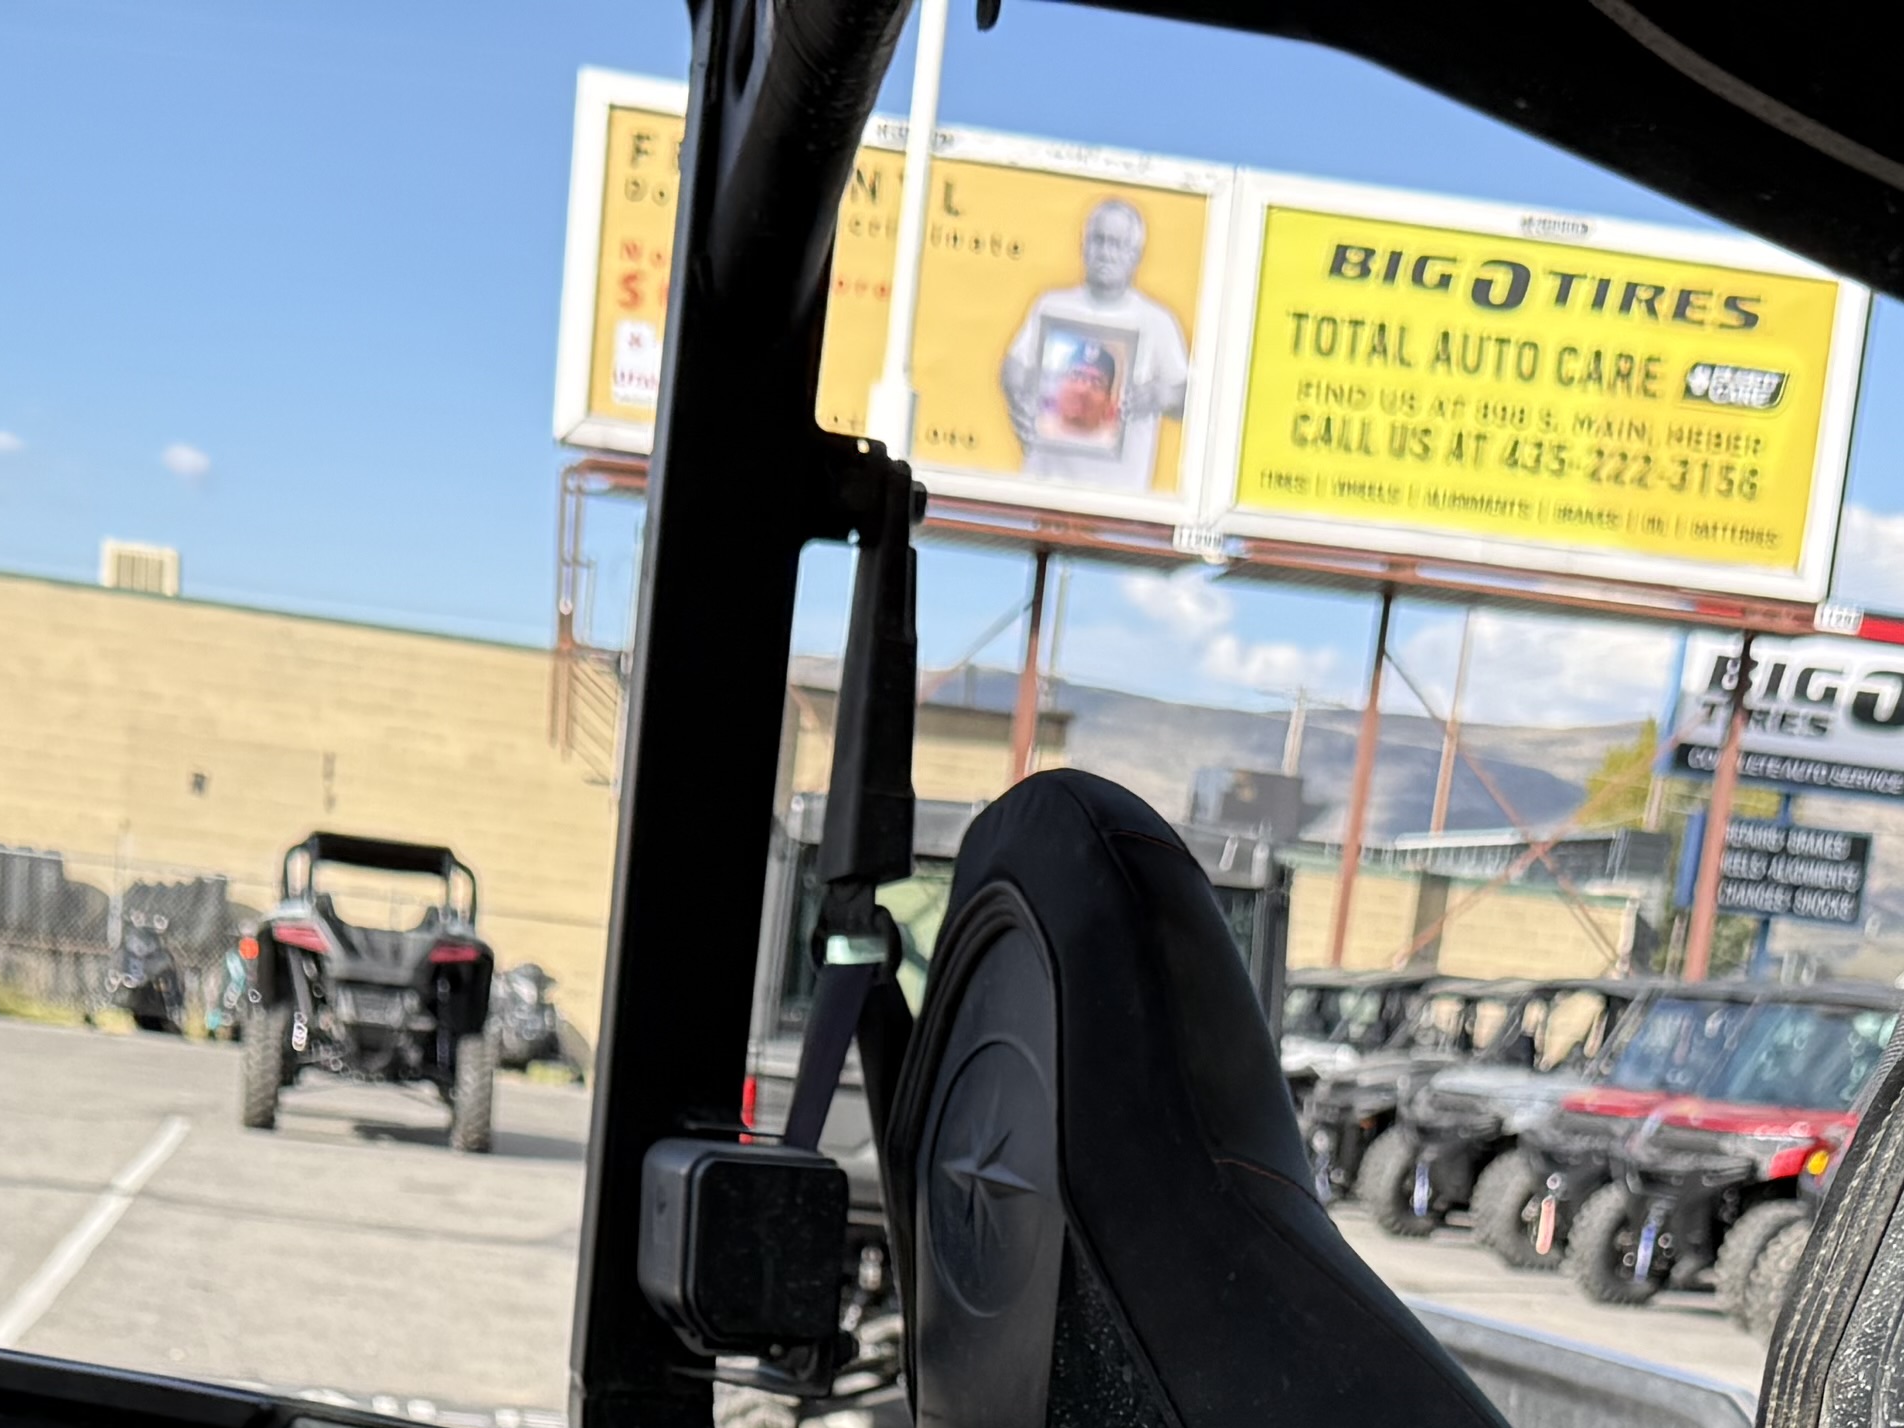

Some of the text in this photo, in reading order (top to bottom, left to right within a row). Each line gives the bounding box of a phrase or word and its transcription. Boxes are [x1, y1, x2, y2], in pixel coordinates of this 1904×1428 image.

[1329, 243, 1455, 292] BIG
[1550, 270, 1763, 331] TIRES
[1290, 311, 1413, 367] TOTAL
[1429, 328, 1540, 383] AUTO
[1556, 346, 1663, 398] CARE
[1296, 379, 1372, 411] FIND
[1379, 386, 1419, 417] US
[1429, 393, 1467, 421] AT
[1291, 411, 1760, 502] CALL US AT 435-222-3156
[1701, 699, 1830, 738] TRES
